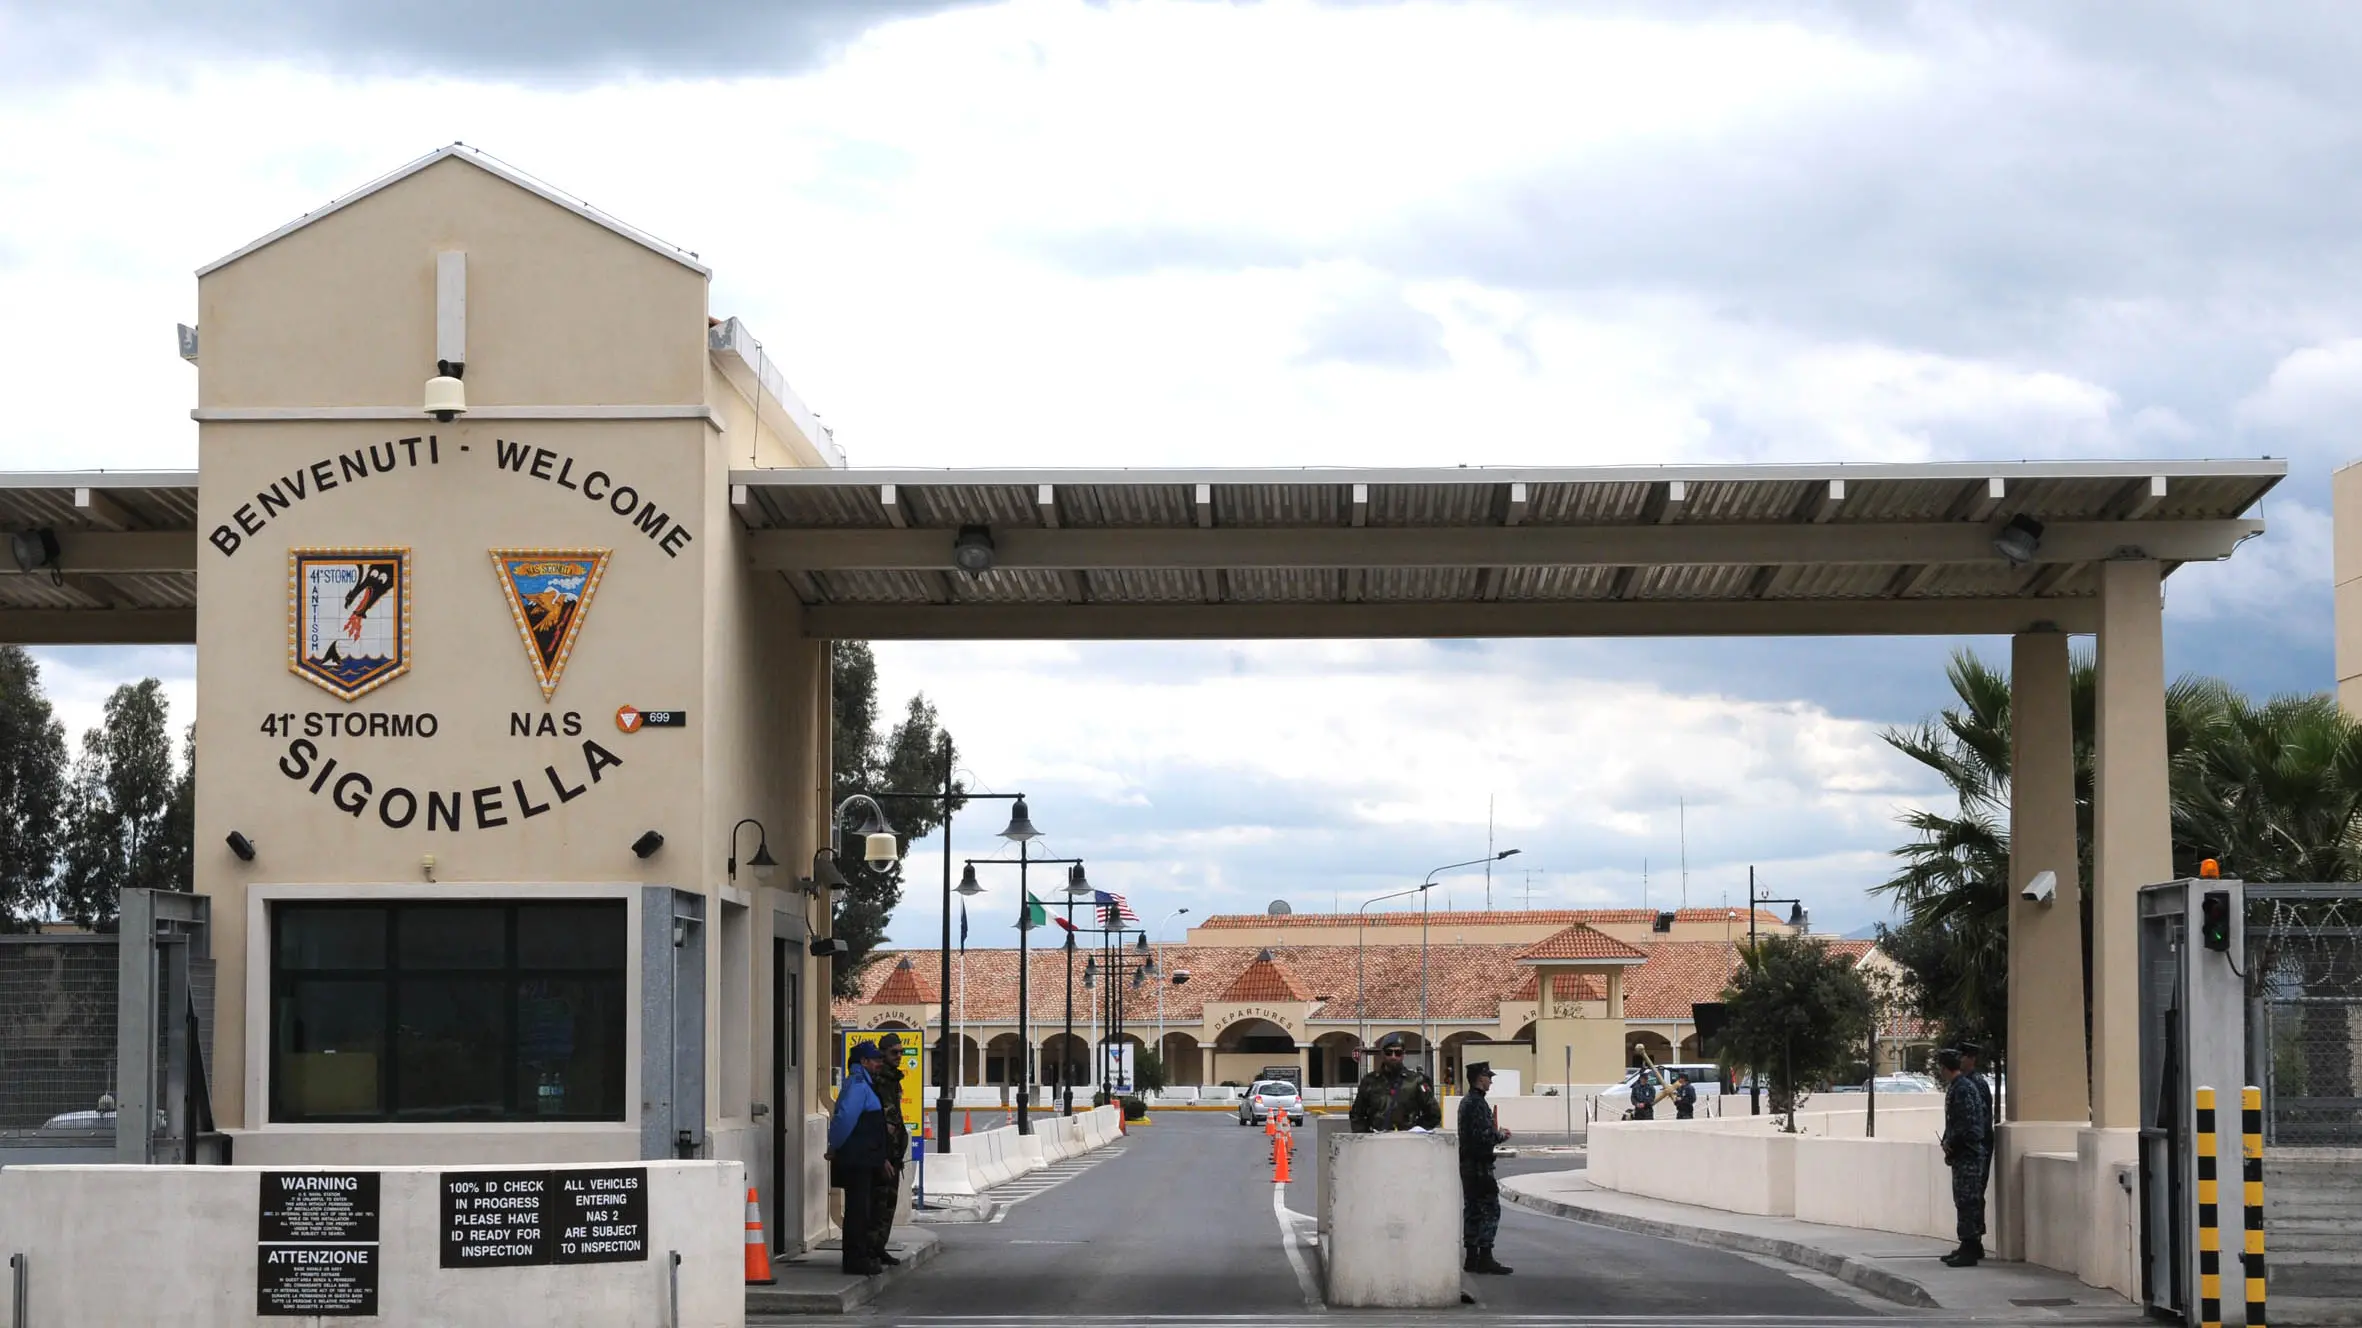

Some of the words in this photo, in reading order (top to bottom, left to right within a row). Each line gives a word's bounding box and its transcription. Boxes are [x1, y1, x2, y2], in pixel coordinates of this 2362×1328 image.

[208, 435, 439, 557] BENVENUTI
[496, 439, 693, 559] WELCOME
[324, 569, 357, 583] STORMO
[510, 711, 582, 737] NAS
[649, 712, 670, 723] 699
[303, 712, 438, 738] STORMO
[278, 738, 624, 832] SIGONELLA
[863, 1010, 922, 1030] ESTAURAN
[1214, 1008, 1294, 1030] DEPARTURES
[280, 1176, 358, 1190] WARNING
[449, 1182, 479, 1194] 100%
[485, 1181, 498, 1193] ID
[503, 1180, 544, 1193] CHECK
[564, 1179, 585, 1191] ALL
[589, 1177, 639, 1190] VEHICLES
[455, 1198, 468, 1210] IN
[474, 1197, 540, 1209] PROGRESS
[575, 1193, 627, 1207] ENTERING
[454, 1214, 502, 1226] PLEASE
[507, 1212, 539, 1224] HAVE
[586, 1210, 608, 1222] NAS
[612, 1210, 619, 1221] 2
[451, 1230, 464, 1242] ID
[469, 1229, 511, 1241] READY
[516, 1228, 541, 1240] FOR
[564, 1226, 588, 1239] ARE
[592, 1224, 638, 1238] SUBJECT
[461, 1244, 533, 1258] INSPECTION
[560, 1242, 576, 1254] TO
[581, 1239, 641, 1254] INSPECTION
[267, 1250, 368, 1264] ATTENZIONE
